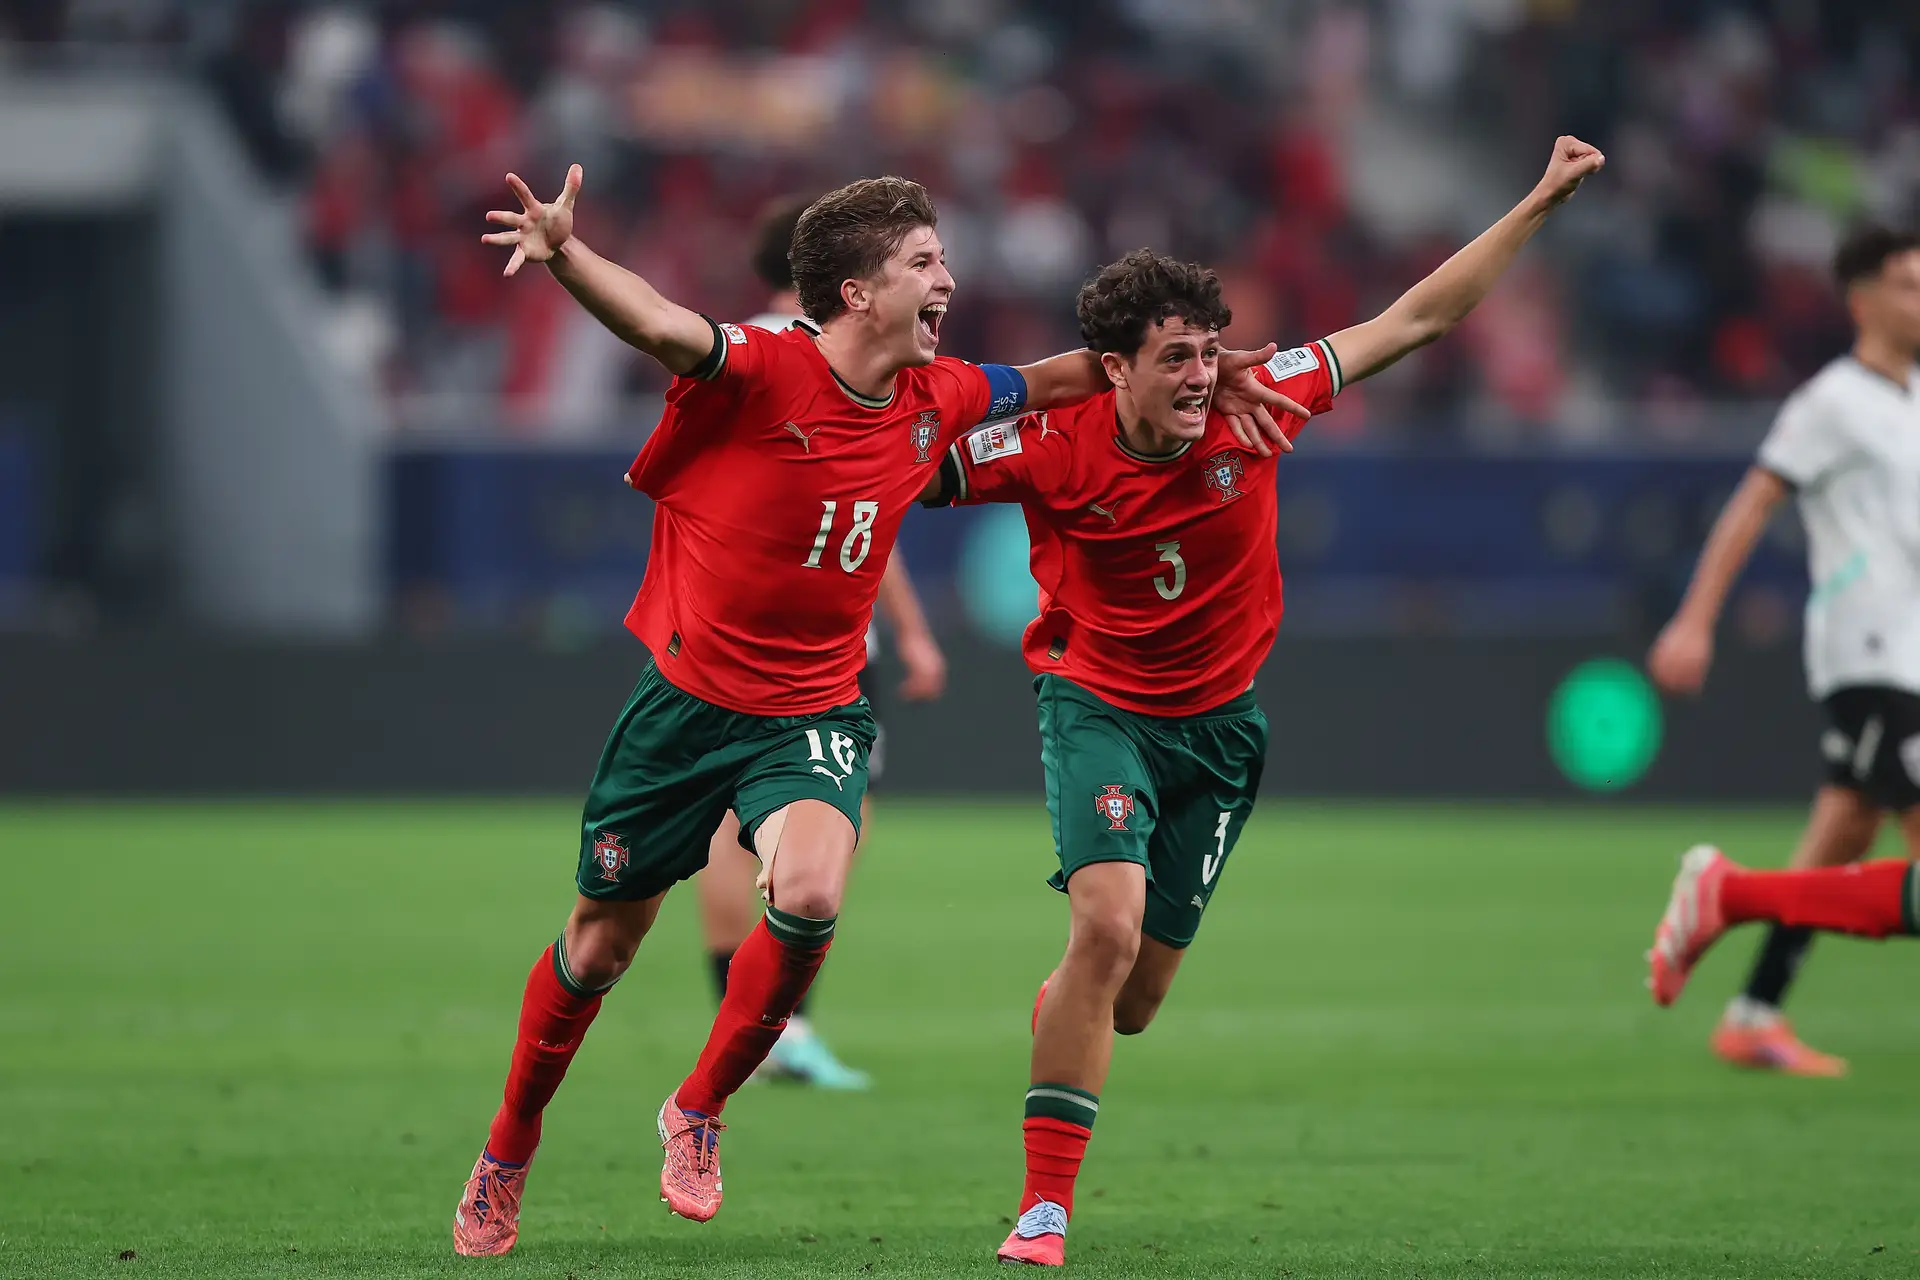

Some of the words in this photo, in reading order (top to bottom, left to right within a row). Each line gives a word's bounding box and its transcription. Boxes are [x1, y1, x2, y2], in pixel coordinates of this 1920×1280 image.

[801, 500, 880, 573] 18
[1153, 540, 1187, 600] 3
[805, 729, 856, 775] 18
[1202, 811, 1231, 886] 3
